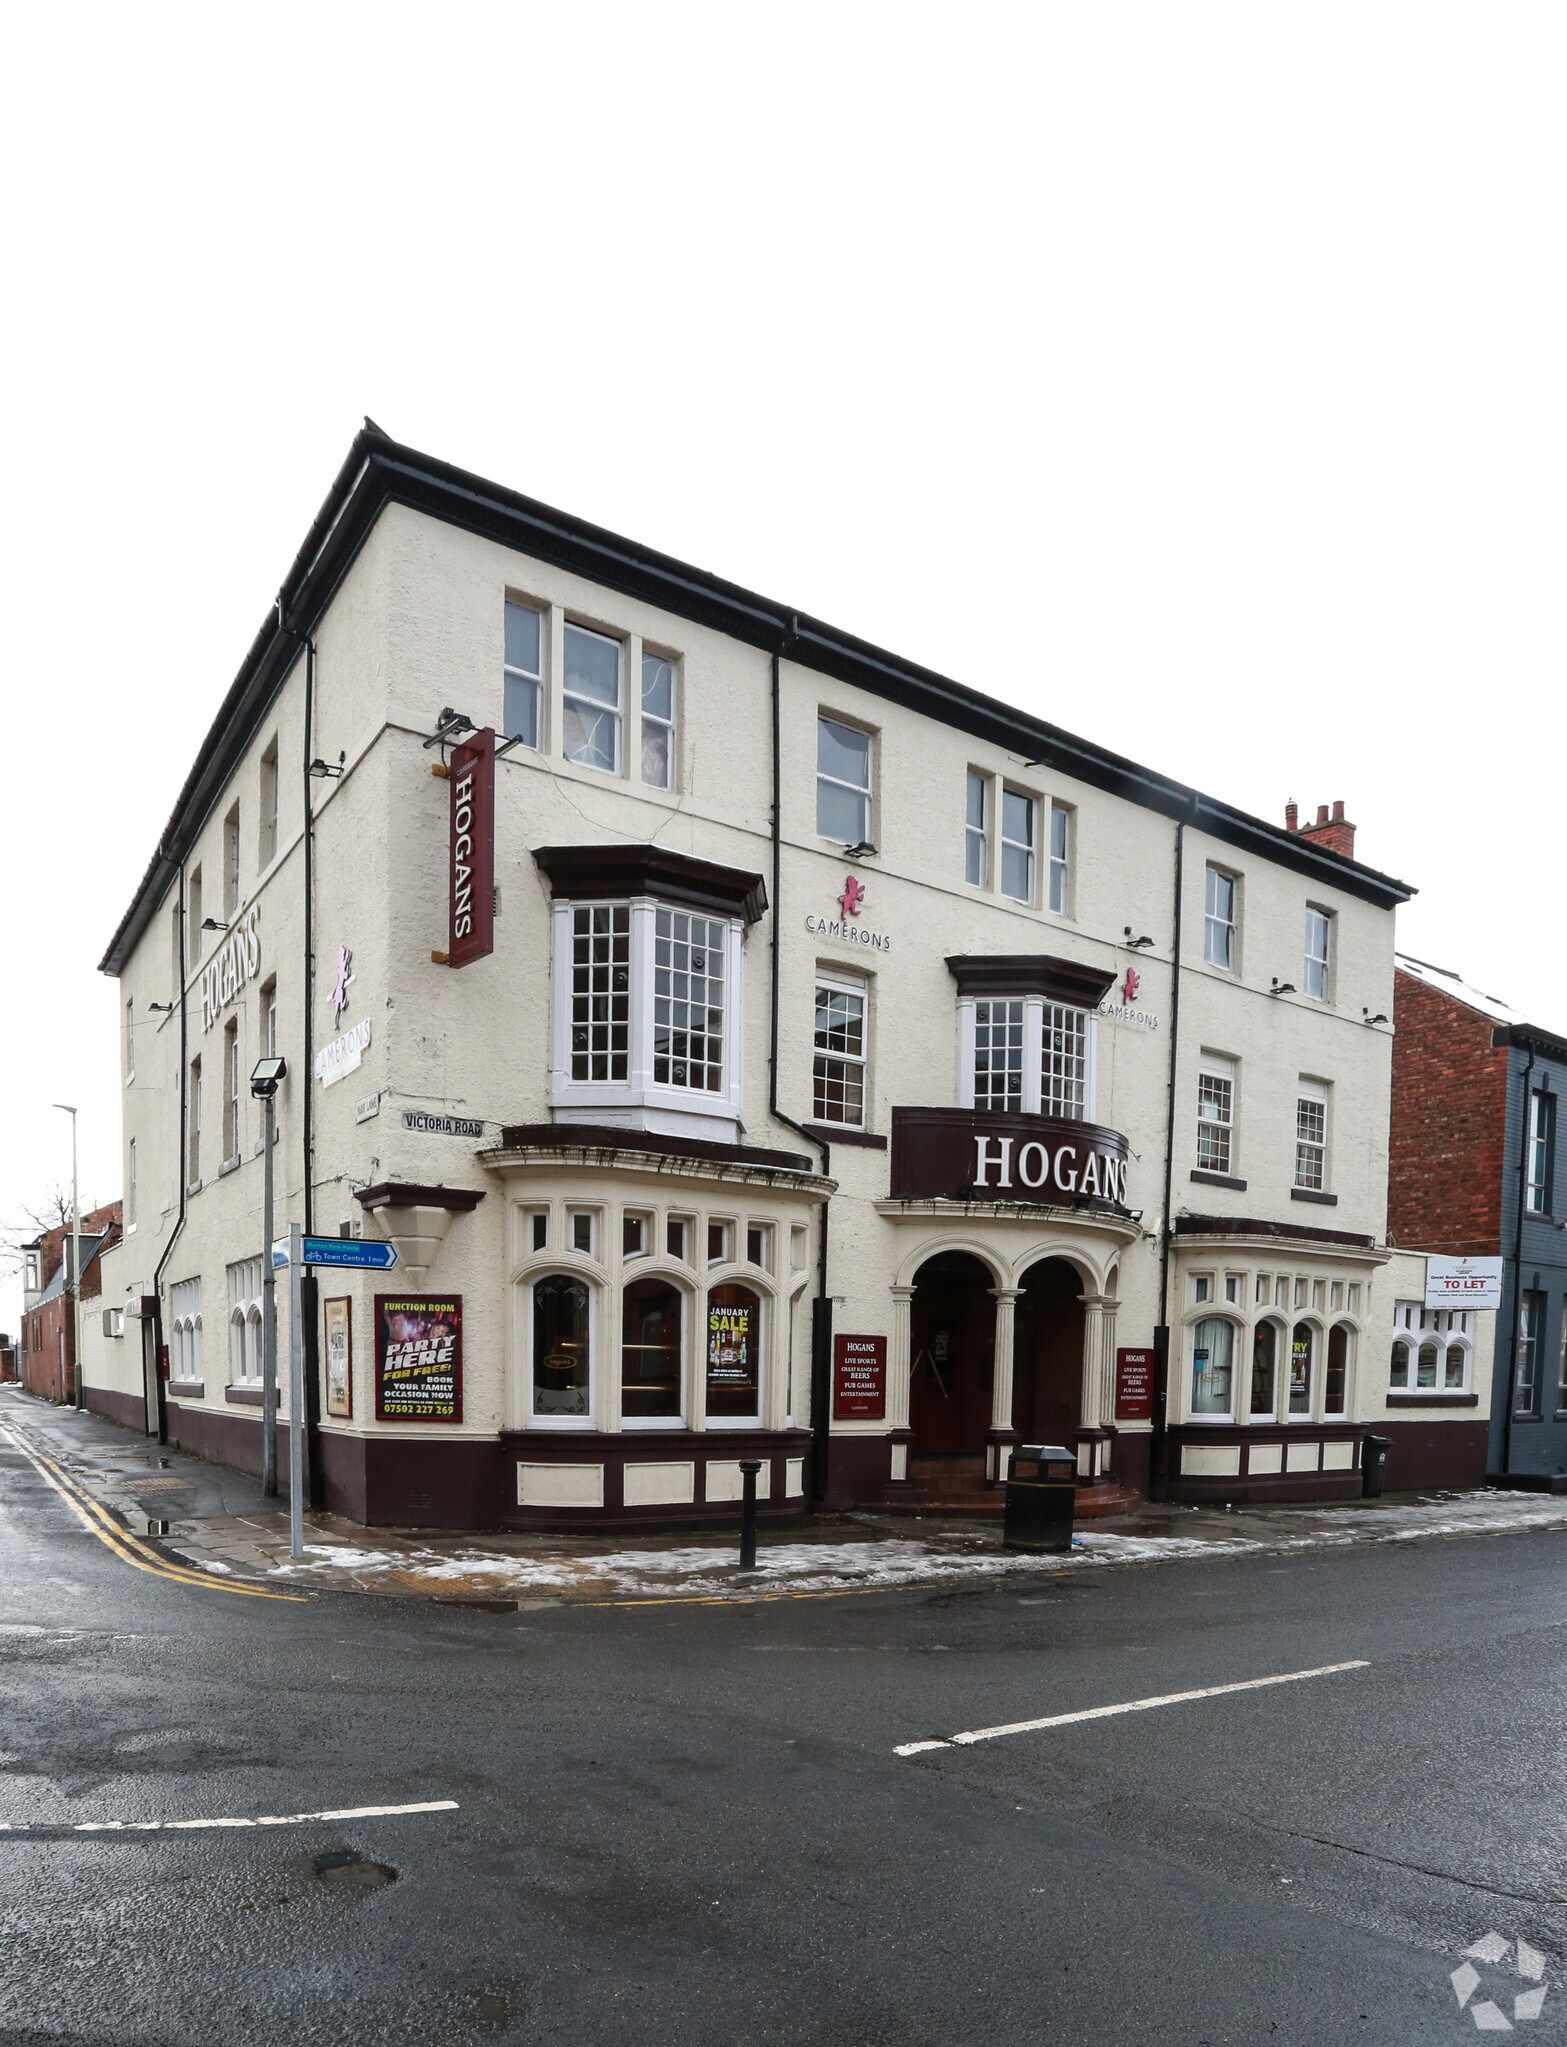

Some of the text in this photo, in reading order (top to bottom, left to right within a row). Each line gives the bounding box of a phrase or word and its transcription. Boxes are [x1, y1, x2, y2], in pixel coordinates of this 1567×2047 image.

[455, 773, 472, 940] HOGANS
[806, 915, 891, 951] CAMERONS
[201, 902, 260, 1031] HOGANS
[1099, 1001, 1159, 1029] CAMERONS
[315, 1020, 370, 1077] CAMERONS
[406, 1114, 481, 1135] VICTORIA ROAD
[973, 1136, 1128, 1205] HOGANS
[323, 1252, 341, 1260] Town
[342, 1254, 365, 1262] Centre
[1444, 1280, 1486, 1289] TO LET
[384, 1303, 454, 1312] FUNCTION ROOM
[710, 1307, 749, 1316] JANUARY
[710, 1315, 748, 1331] SALE
[386, 1335, 457, 1356] PARTY
[847, 1342, 875, 1352] HOGANS
[384, 1347, 454, 1371] HERE
[1125, 1354, 1146, 1362] HOGANS
[383, 1363, 452, 1380] FOR FREE!
[384, 1404, 454, 1414] 07502 227 269
